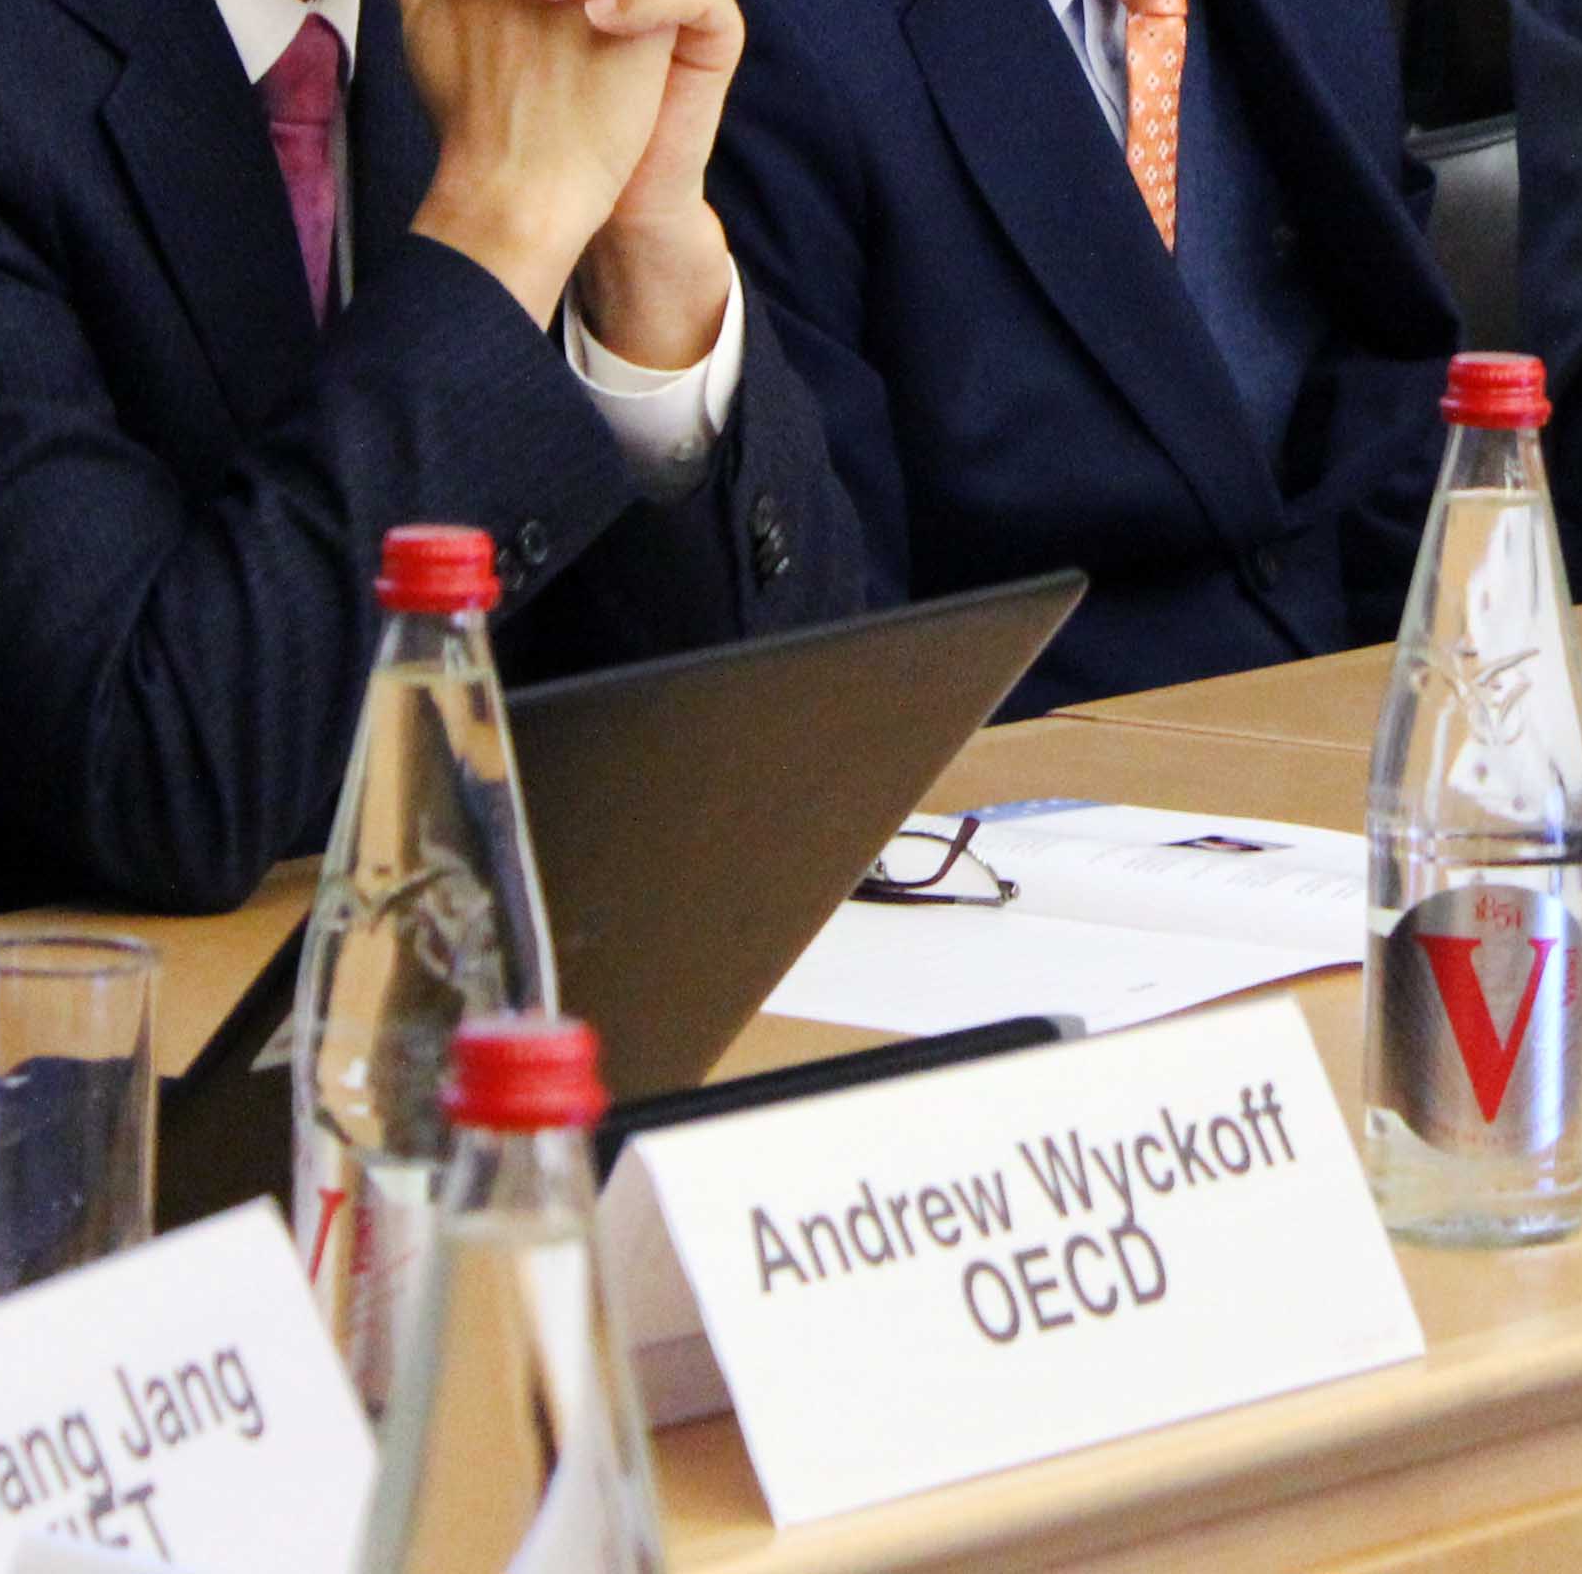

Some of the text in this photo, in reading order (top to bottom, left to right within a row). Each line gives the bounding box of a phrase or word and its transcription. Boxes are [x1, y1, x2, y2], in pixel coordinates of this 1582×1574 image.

[1412, 934, 1558, 1125] V
[749, 1082, 1298, 1294] Andrew Wyckoff
[961, 1226, 1169, 1345] OECD
[116, 1344, 265, 1460] Jang
